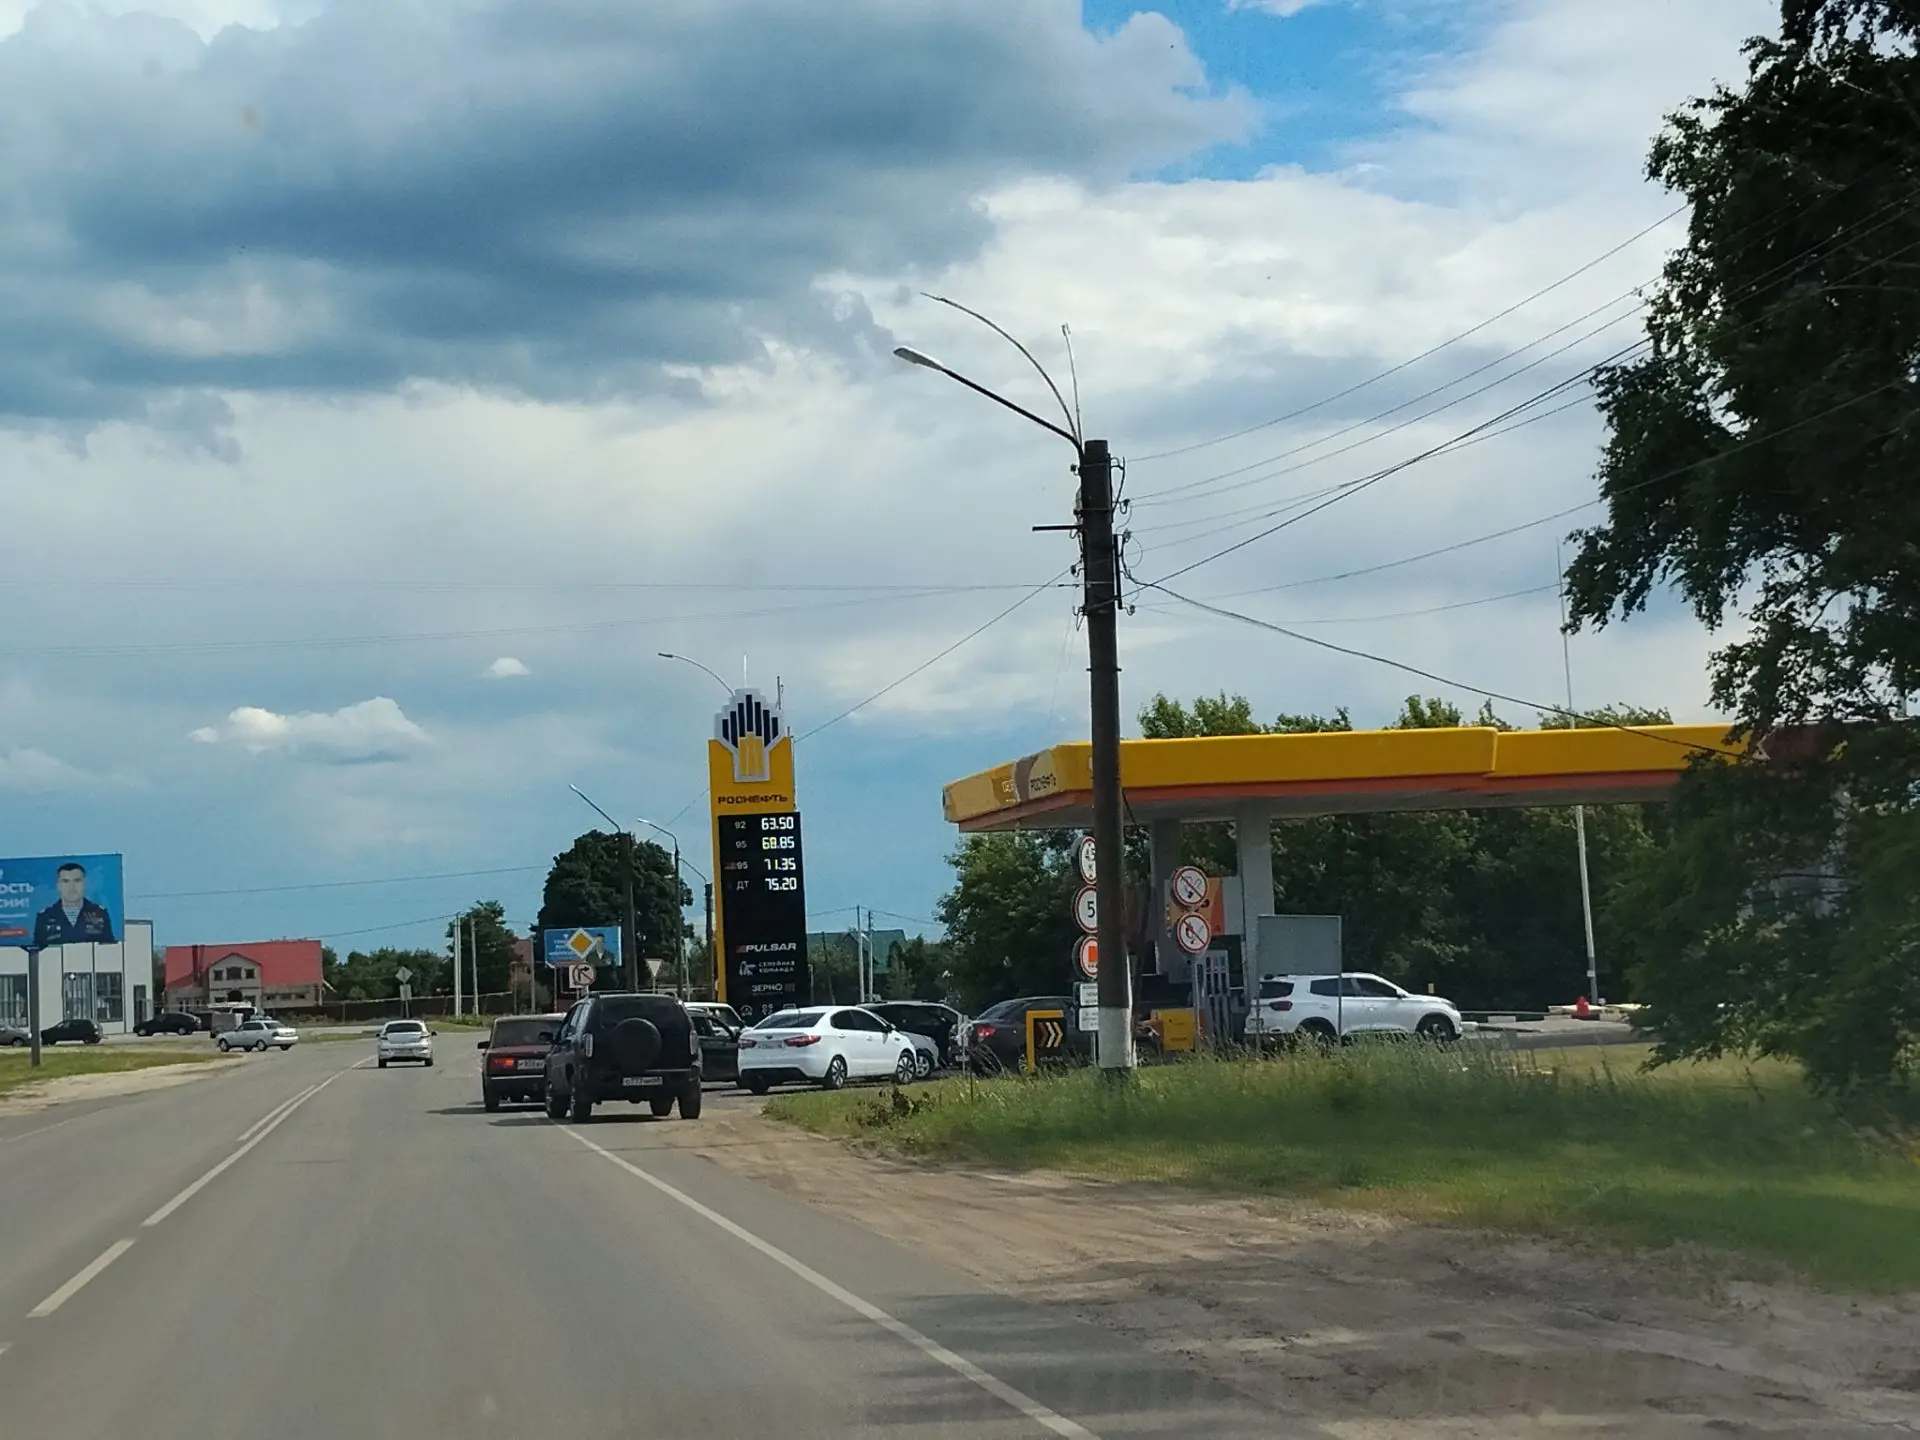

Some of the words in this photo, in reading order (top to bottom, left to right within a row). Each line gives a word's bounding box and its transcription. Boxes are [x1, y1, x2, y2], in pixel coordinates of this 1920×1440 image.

[717, 794, 788, 805] РОСНЕФТЬ
[735, 821, 746, 829] 92
[761, 817, 794, 830] 63.50
[736, 840, 748, 849] 95
[762, 836, 795, 850] 68.85
[764, 857, 797, 871] 71.35
[736, 880, 750, 891] ДТ
[765, 877, 798, 891] 75.20
[1087, 901, 1096, 918] 5
[746, 942, 797, 952] PULSAR
[751, 983, 783, 992] ЗЕРНО
